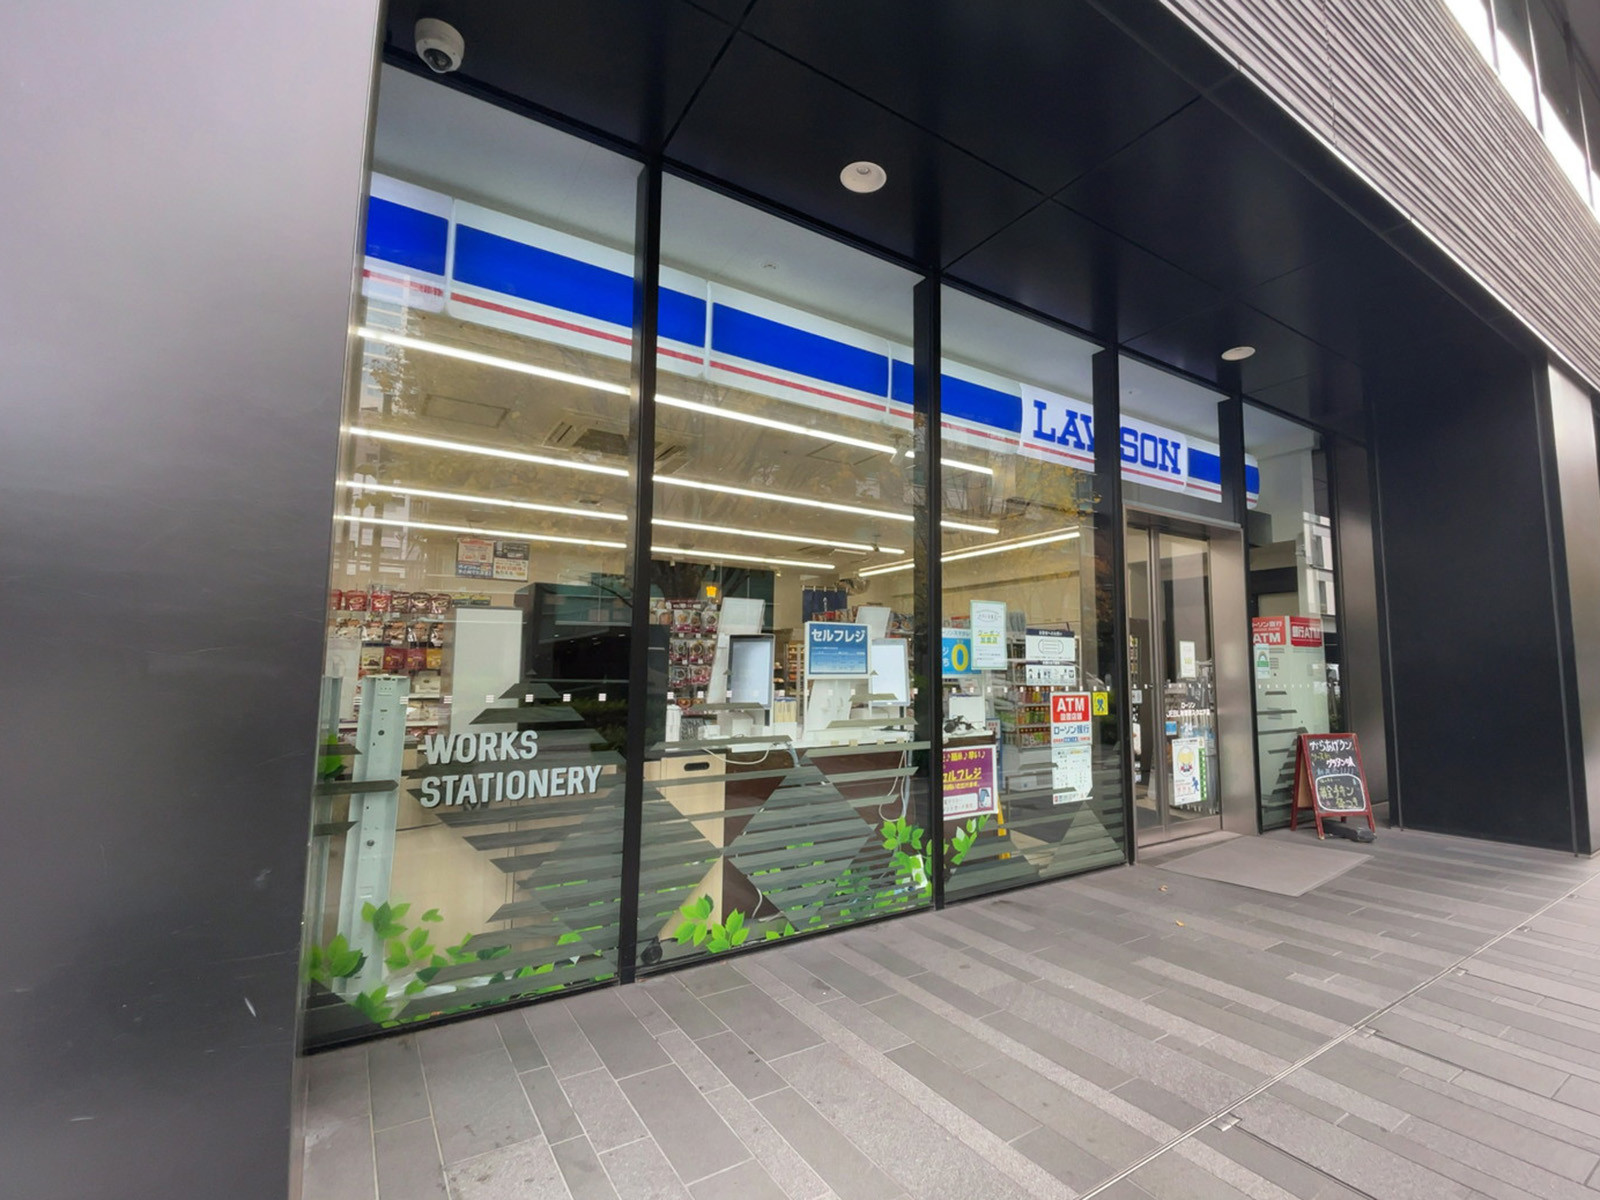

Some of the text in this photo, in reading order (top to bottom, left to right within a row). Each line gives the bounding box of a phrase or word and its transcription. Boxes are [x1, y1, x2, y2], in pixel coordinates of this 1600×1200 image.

[811, 629, 866, 643] セルフレジ
[1253, 632, 1281, 643] ATM
[951, 643, 969, 671] 0
[1057, 697, 1085, 712] ATM
[1054, 725, 1090, 734] ローソン銀行
[424, 730, 539, 766] WORKS
[419, 764, 604, 808] STATIONERY
